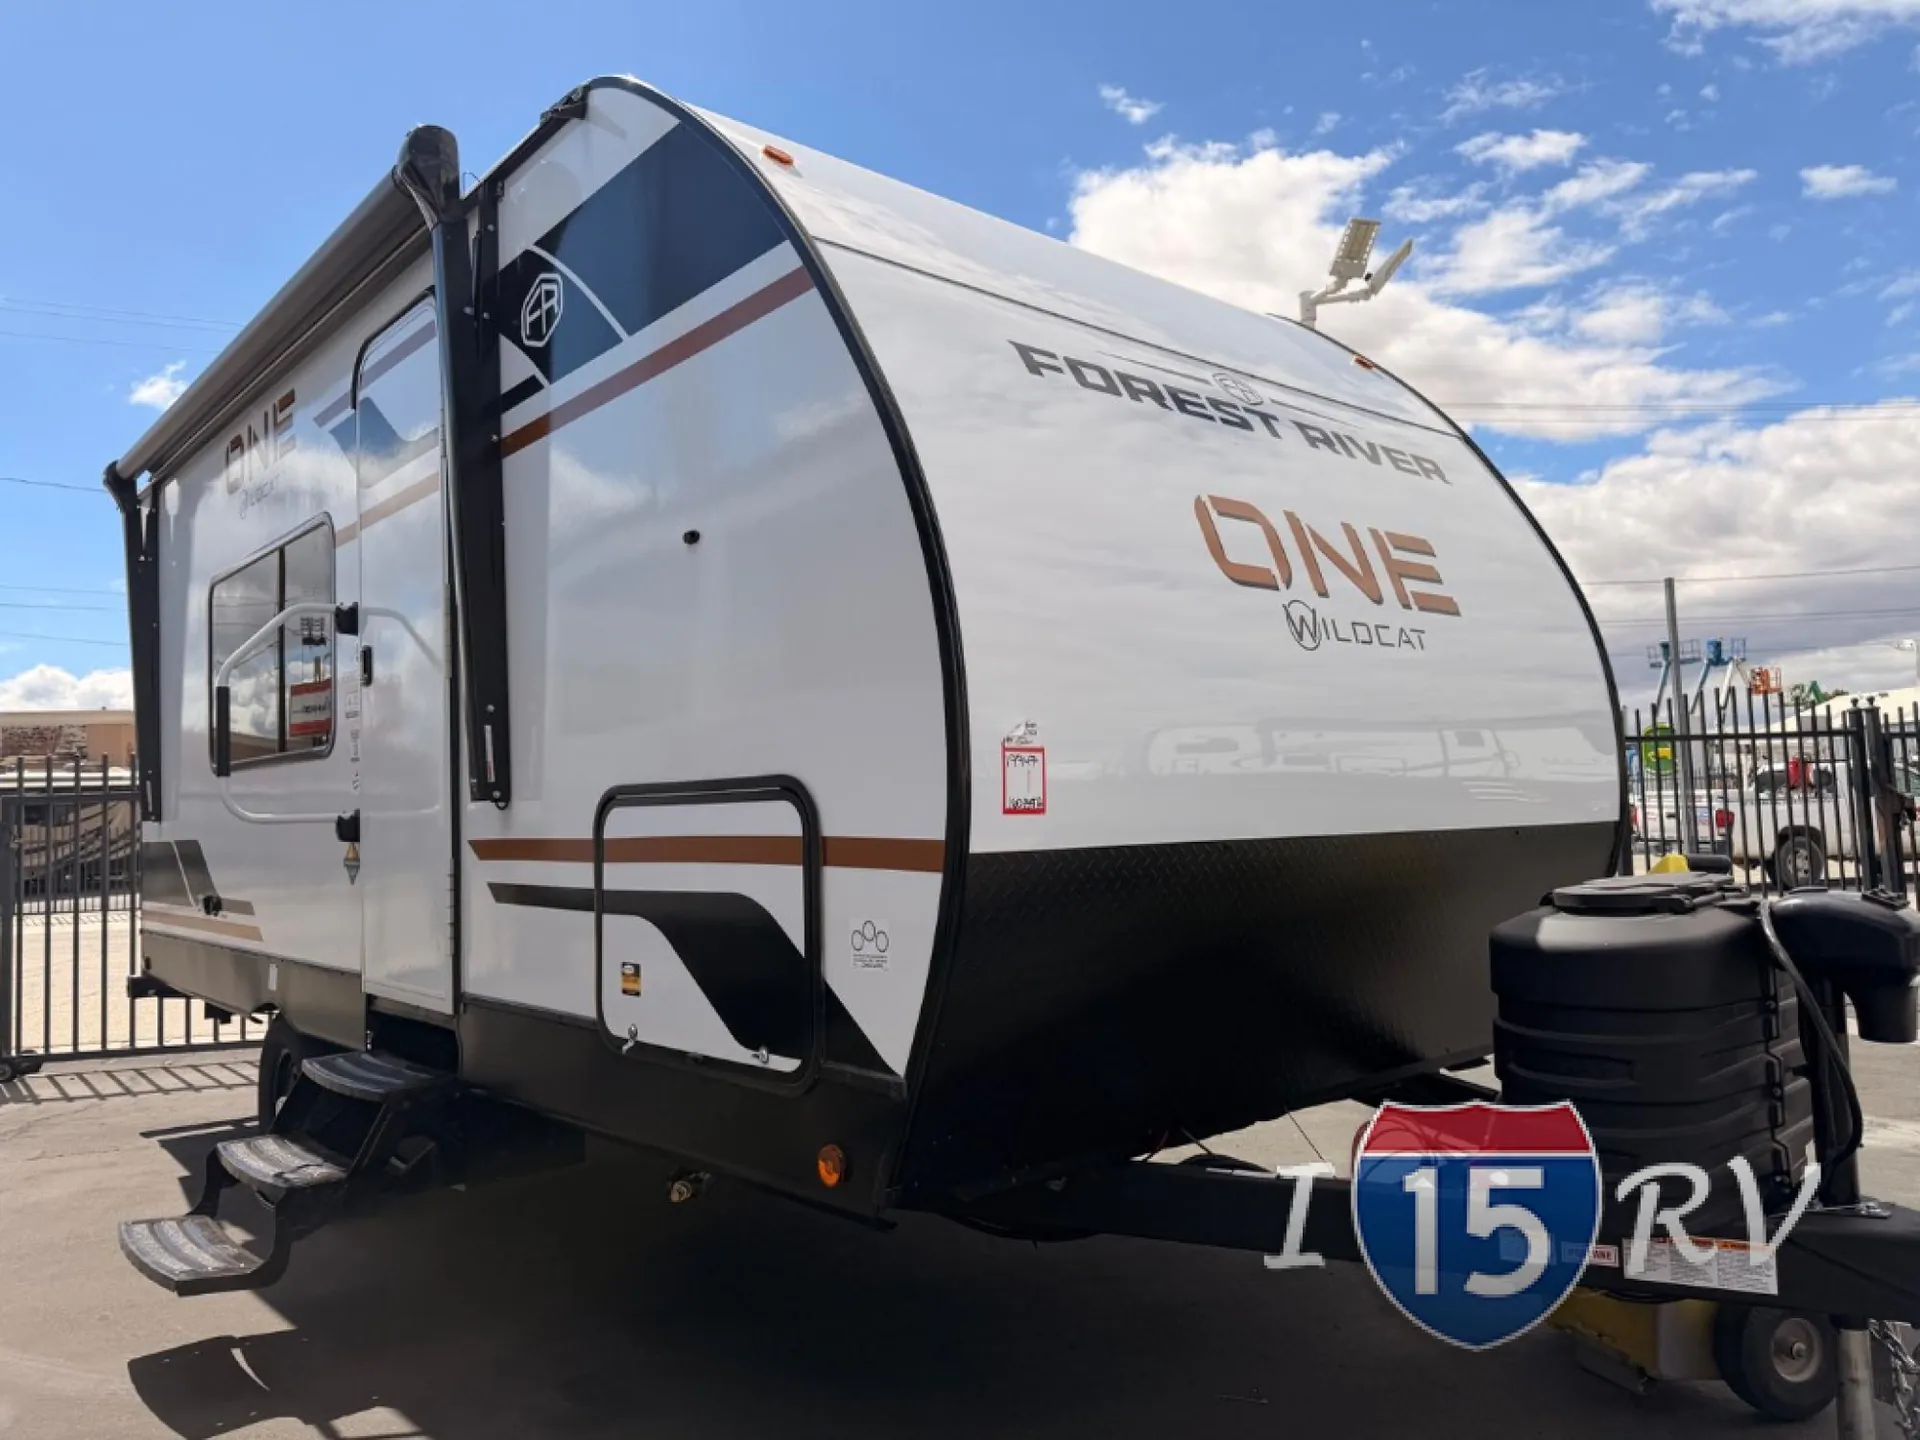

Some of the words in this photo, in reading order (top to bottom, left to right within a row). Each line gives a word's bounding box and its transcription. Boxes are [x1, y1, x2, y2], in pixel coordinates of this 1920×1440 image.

[225, 388, 296, 495] ONE
[1008, 340, 1282, 440] FOREST
[1291, 419, 1452, 484] RIVER
[1194, 494, 1462, 617] ONE
